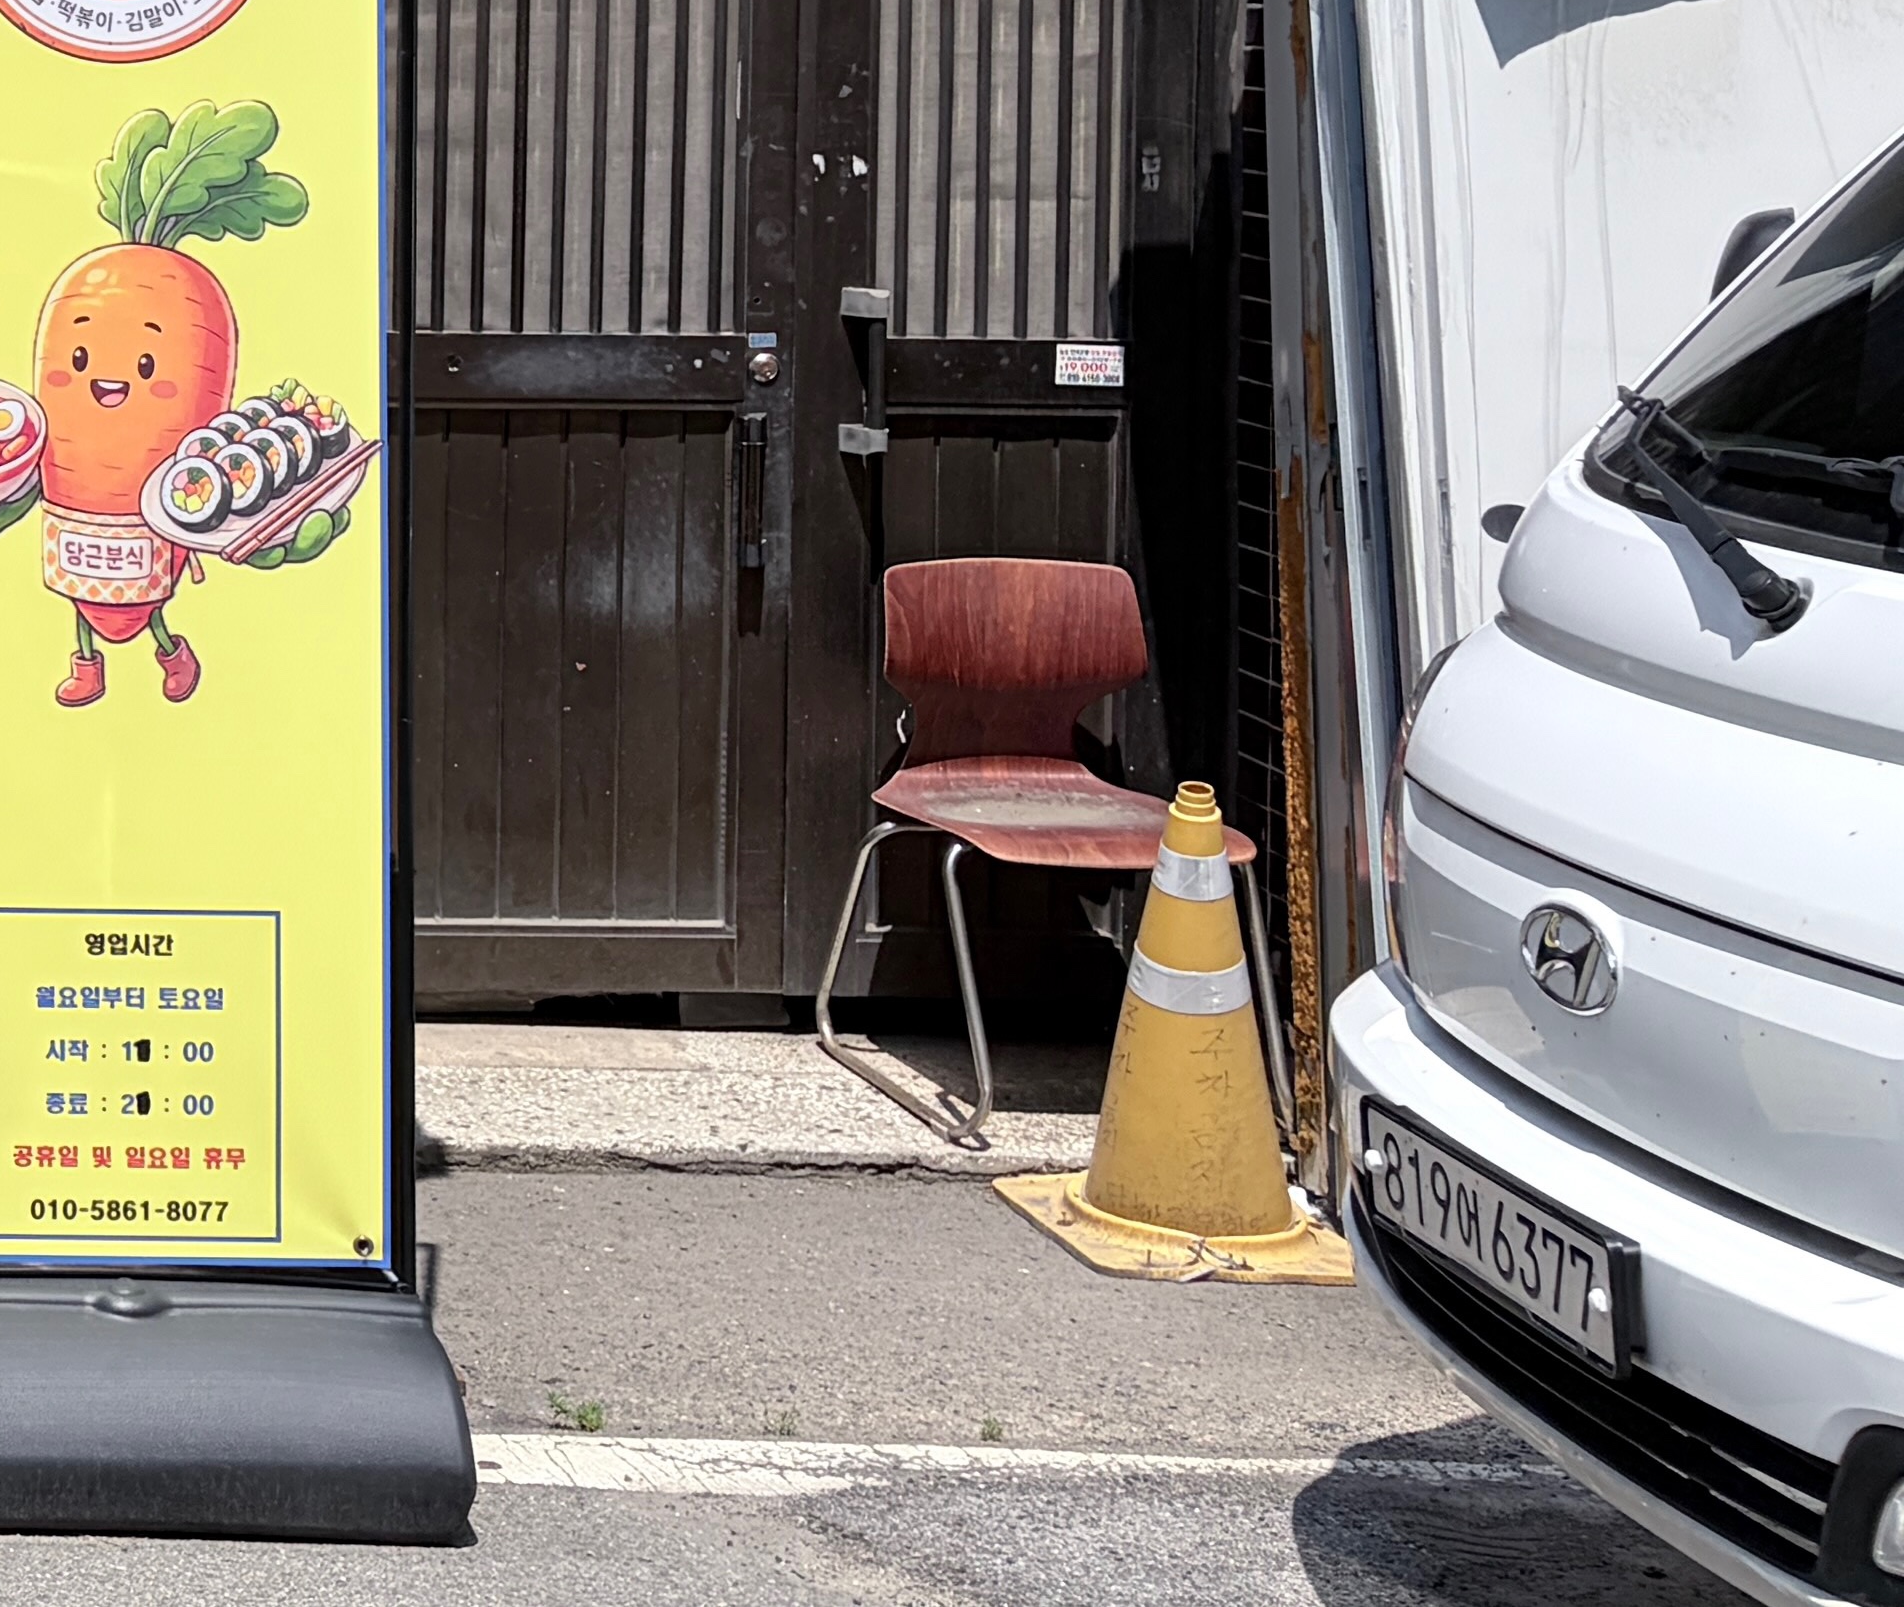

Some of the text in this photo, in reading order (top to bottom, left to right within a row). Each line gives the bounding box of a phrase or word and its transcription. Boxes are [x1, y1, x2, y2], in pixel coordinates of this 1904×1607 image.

[65, 540, 144, 571] 당근분식
[84, 933, 174, 957] 영업시간
[35, 986, 225, 1011] 월요일부터 토요일
[45, 1039, 89, 1062] 시작
[182, 1041, 215, 1063] 00
[45, 1092, 89, 1115] 종료
[121, 1091, 151, 1115] 2
[182, 1094, 215, 1116] 00
[12, 1145, 246, 1170] 공휴일 및 일요일 휴무
[30, 1199, 229, 1222] 010-5861-8077
